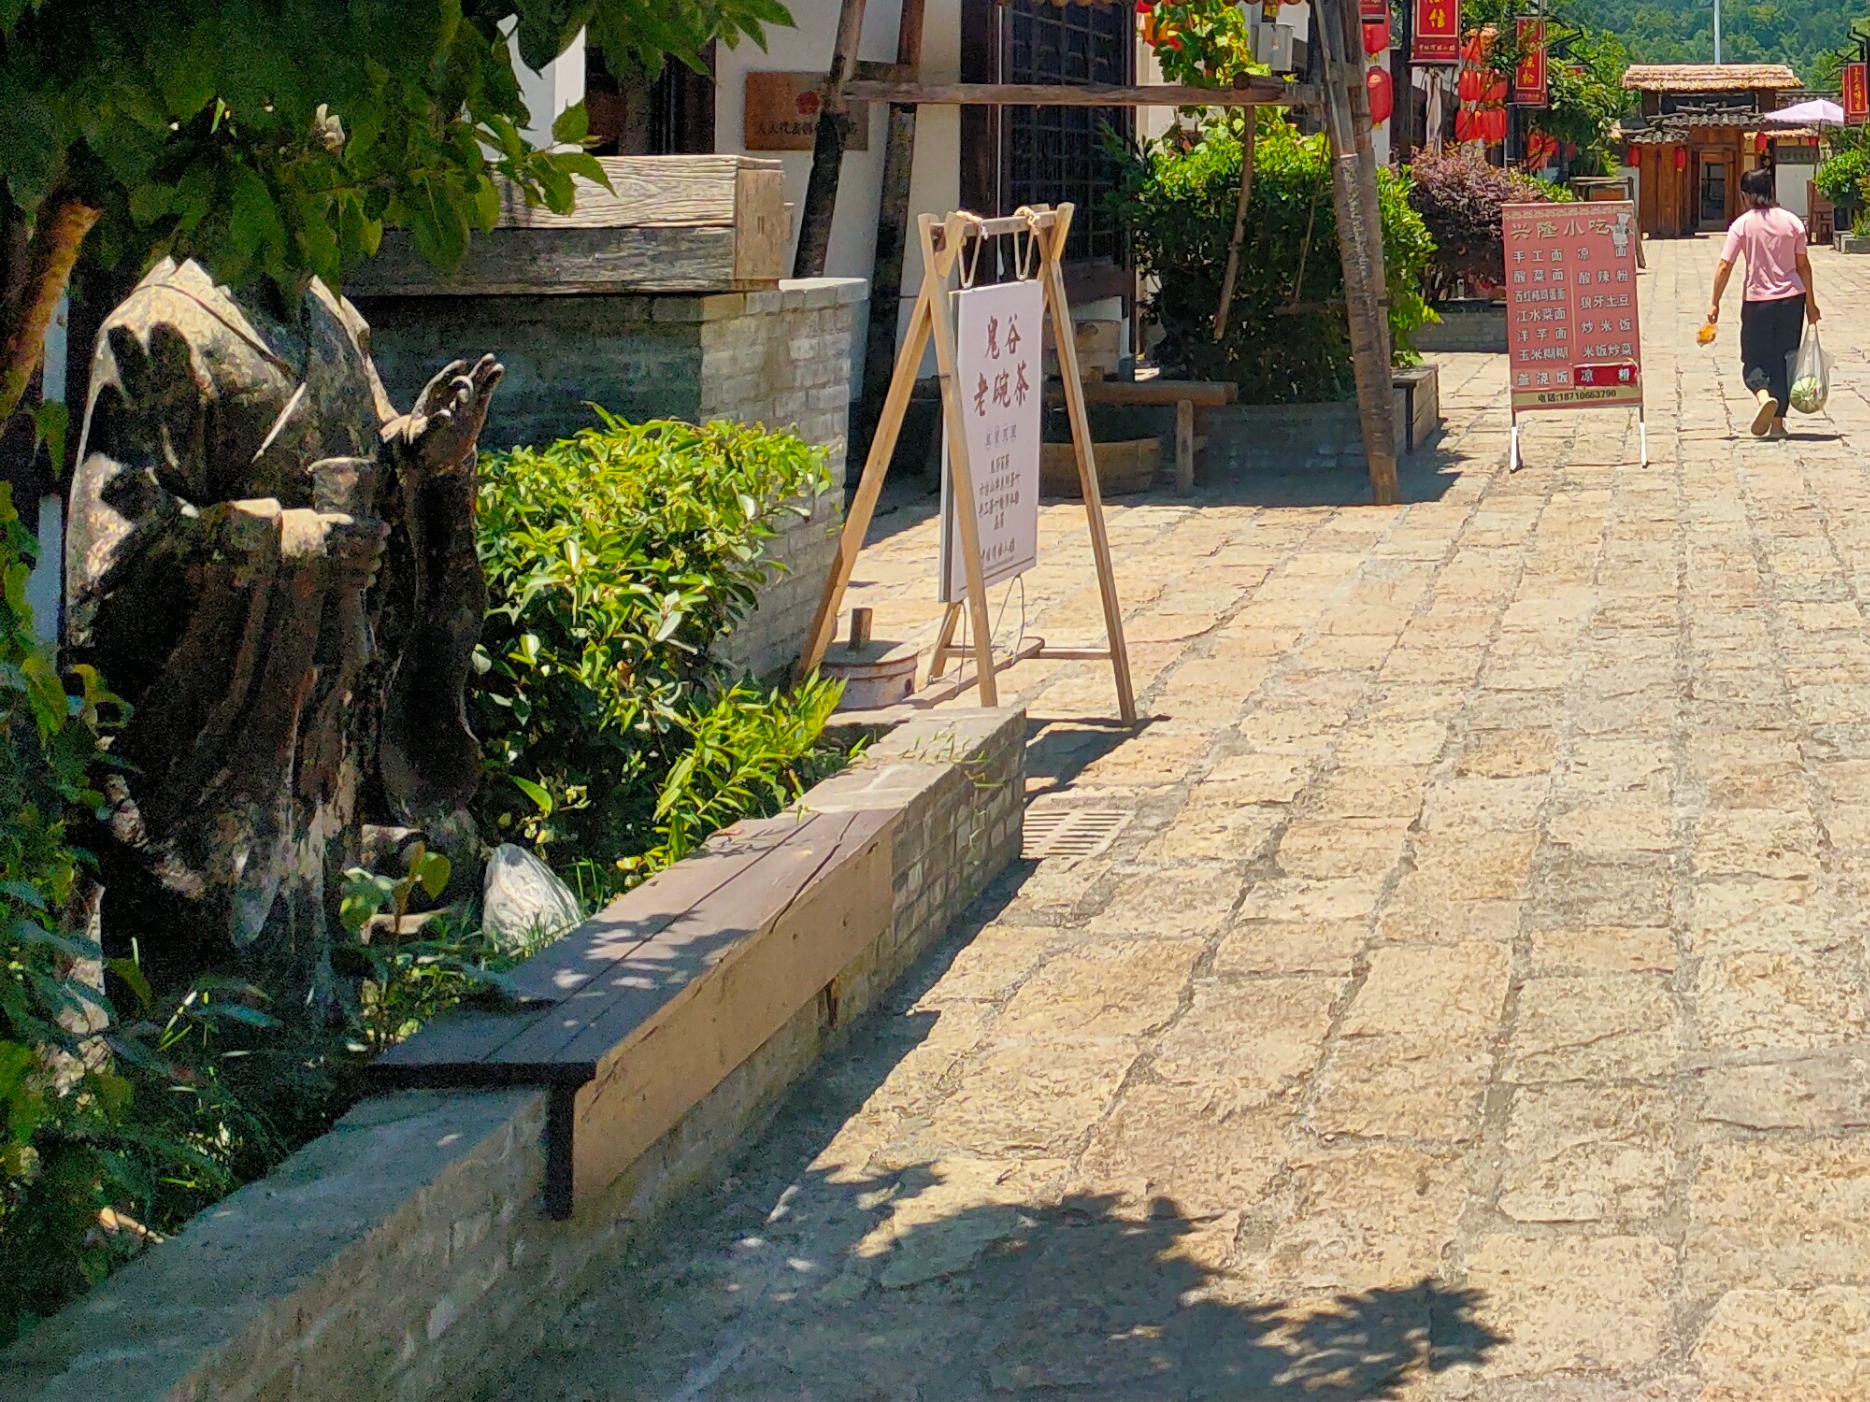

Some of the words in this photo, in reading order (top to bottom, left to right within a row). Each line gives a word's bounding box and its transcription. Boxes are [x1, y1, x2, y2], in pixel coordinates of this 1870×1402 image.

[1510, 218, 1611, 240] 兴隆小吃
[1513, 249, 1563, 264] 手工面
[1513, 268, 1564, 283] 酸菜面
[1578, 270, 1628, 285] 酸辣粉
[1515, 288, 1566, 303] 西红柿鸡蛋面
[1580, 294, 1630, 309] 狼牙土豆
[985, 313, 1021, 359] 鬼谷
[1581, 318, 1631, 333] 炒米饭
[1517, 327, 1567, 342] 洋芋面
[1583, 343, 1632, 358] 米饭炒菜
[1519, 346, 1568, 361] 玉米糊糊
[974, 360, 1030, 416] 老碗茶
